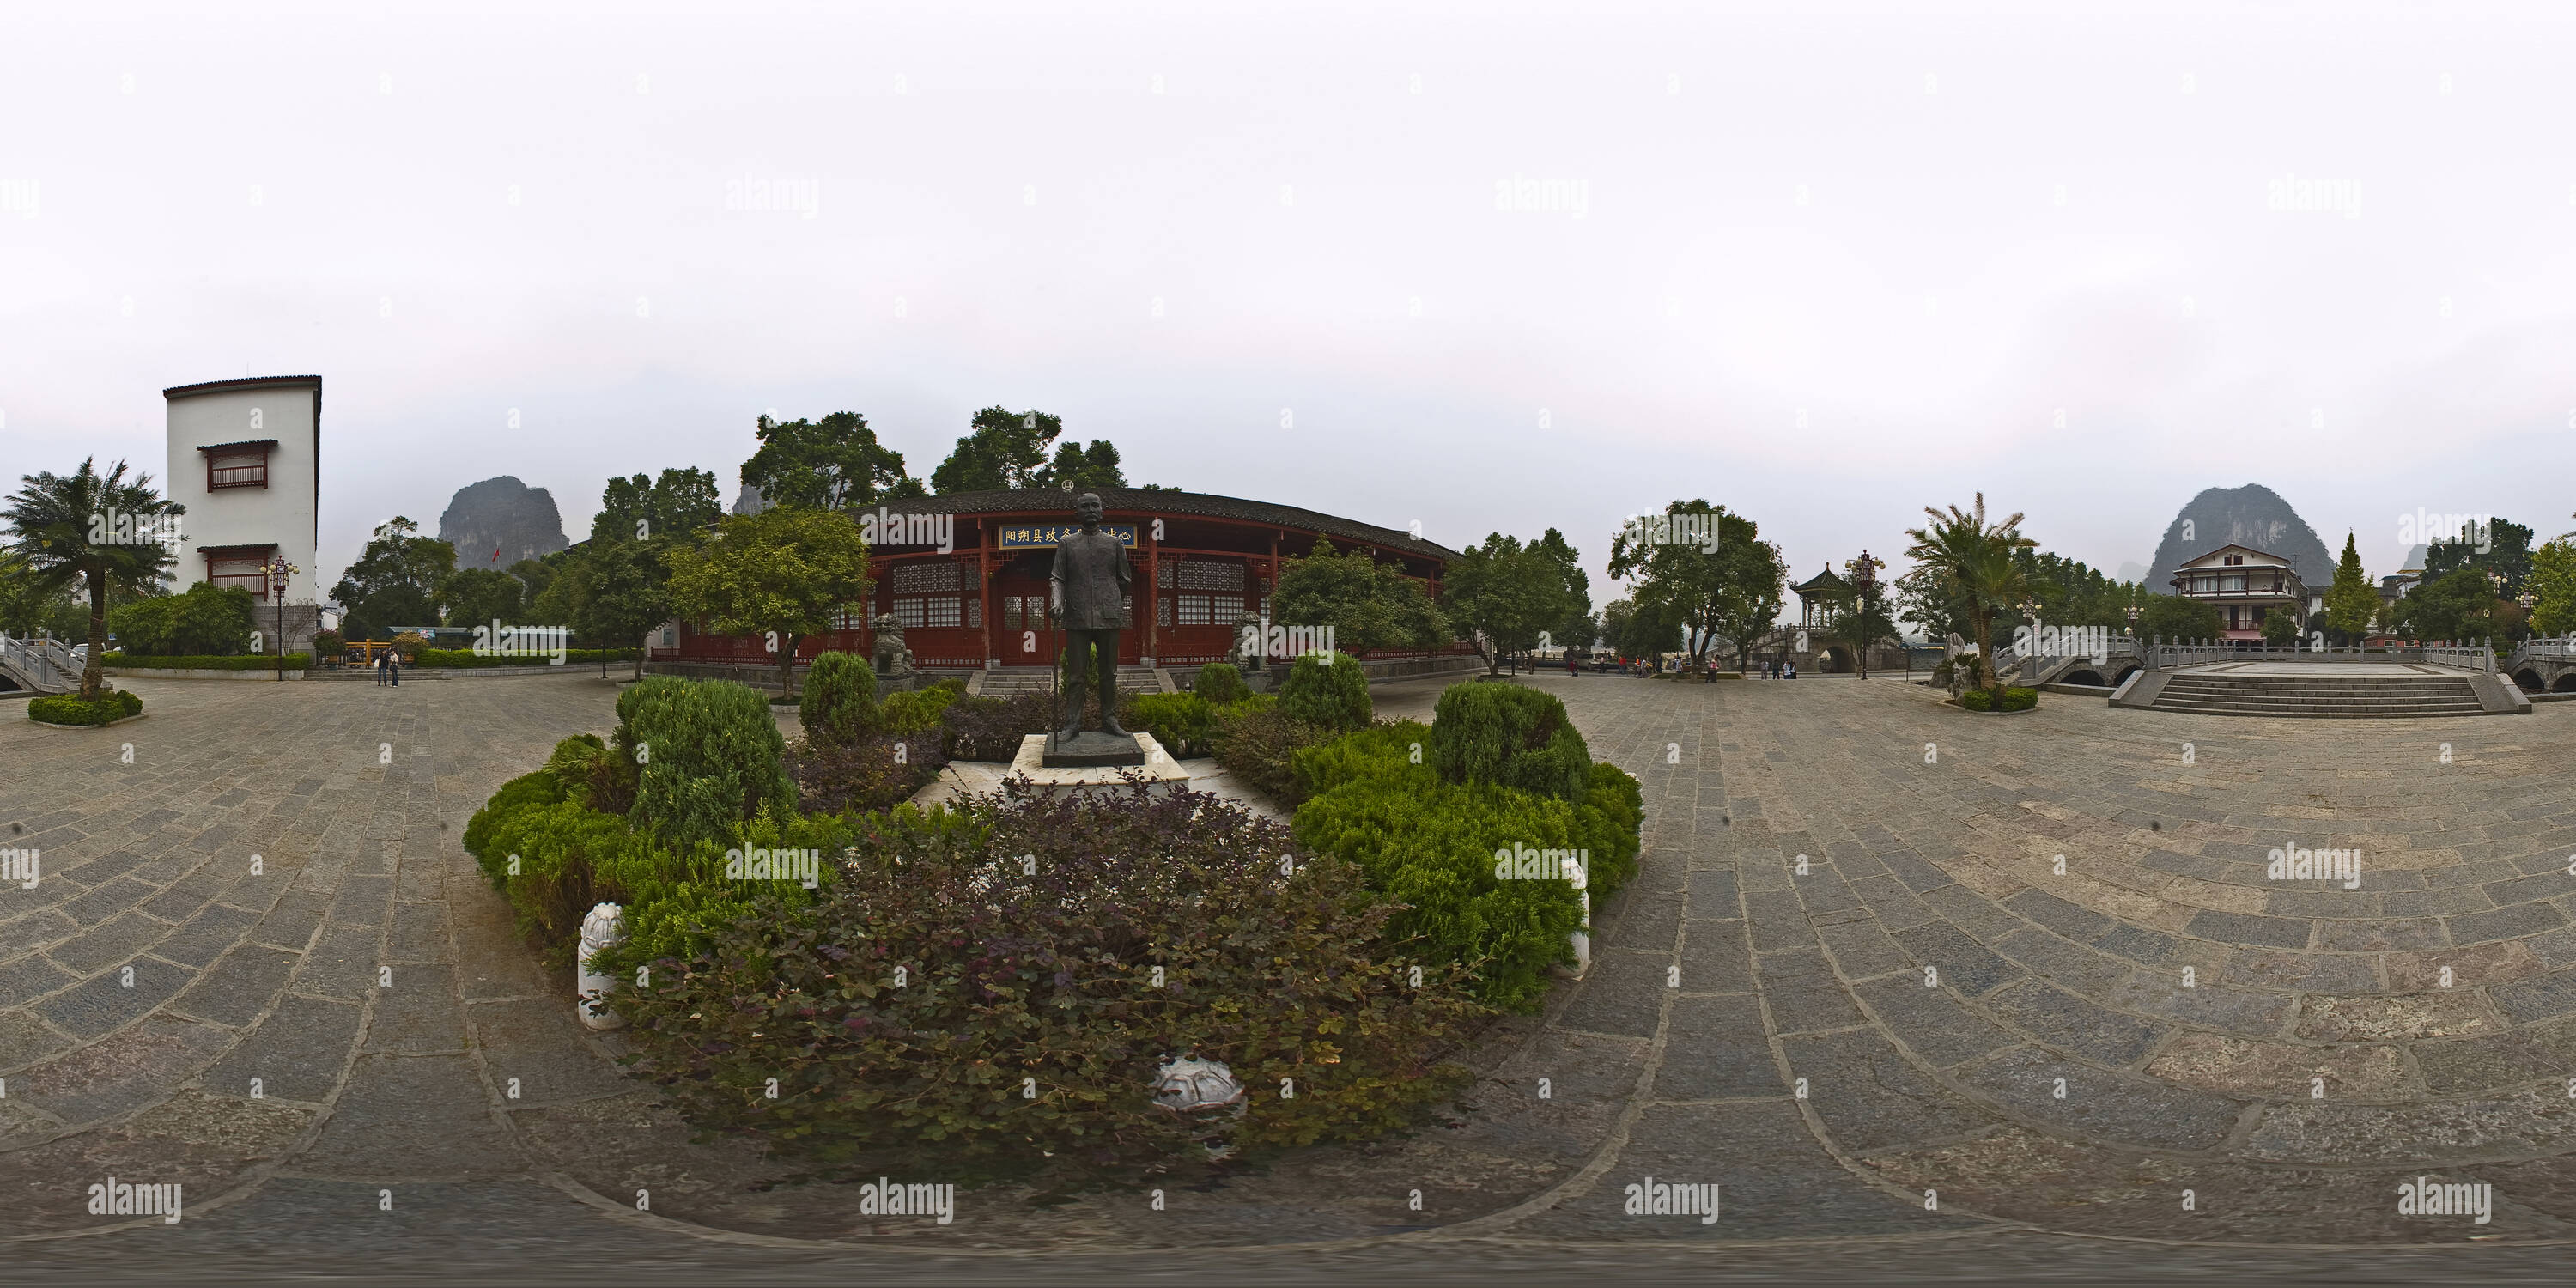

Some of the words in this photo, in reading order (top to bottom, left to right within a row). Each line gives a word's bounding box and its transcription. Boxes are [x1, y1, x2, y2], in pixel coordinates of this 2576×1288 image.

[1005, 527, 1132, 544] 阳朔县政务中心
